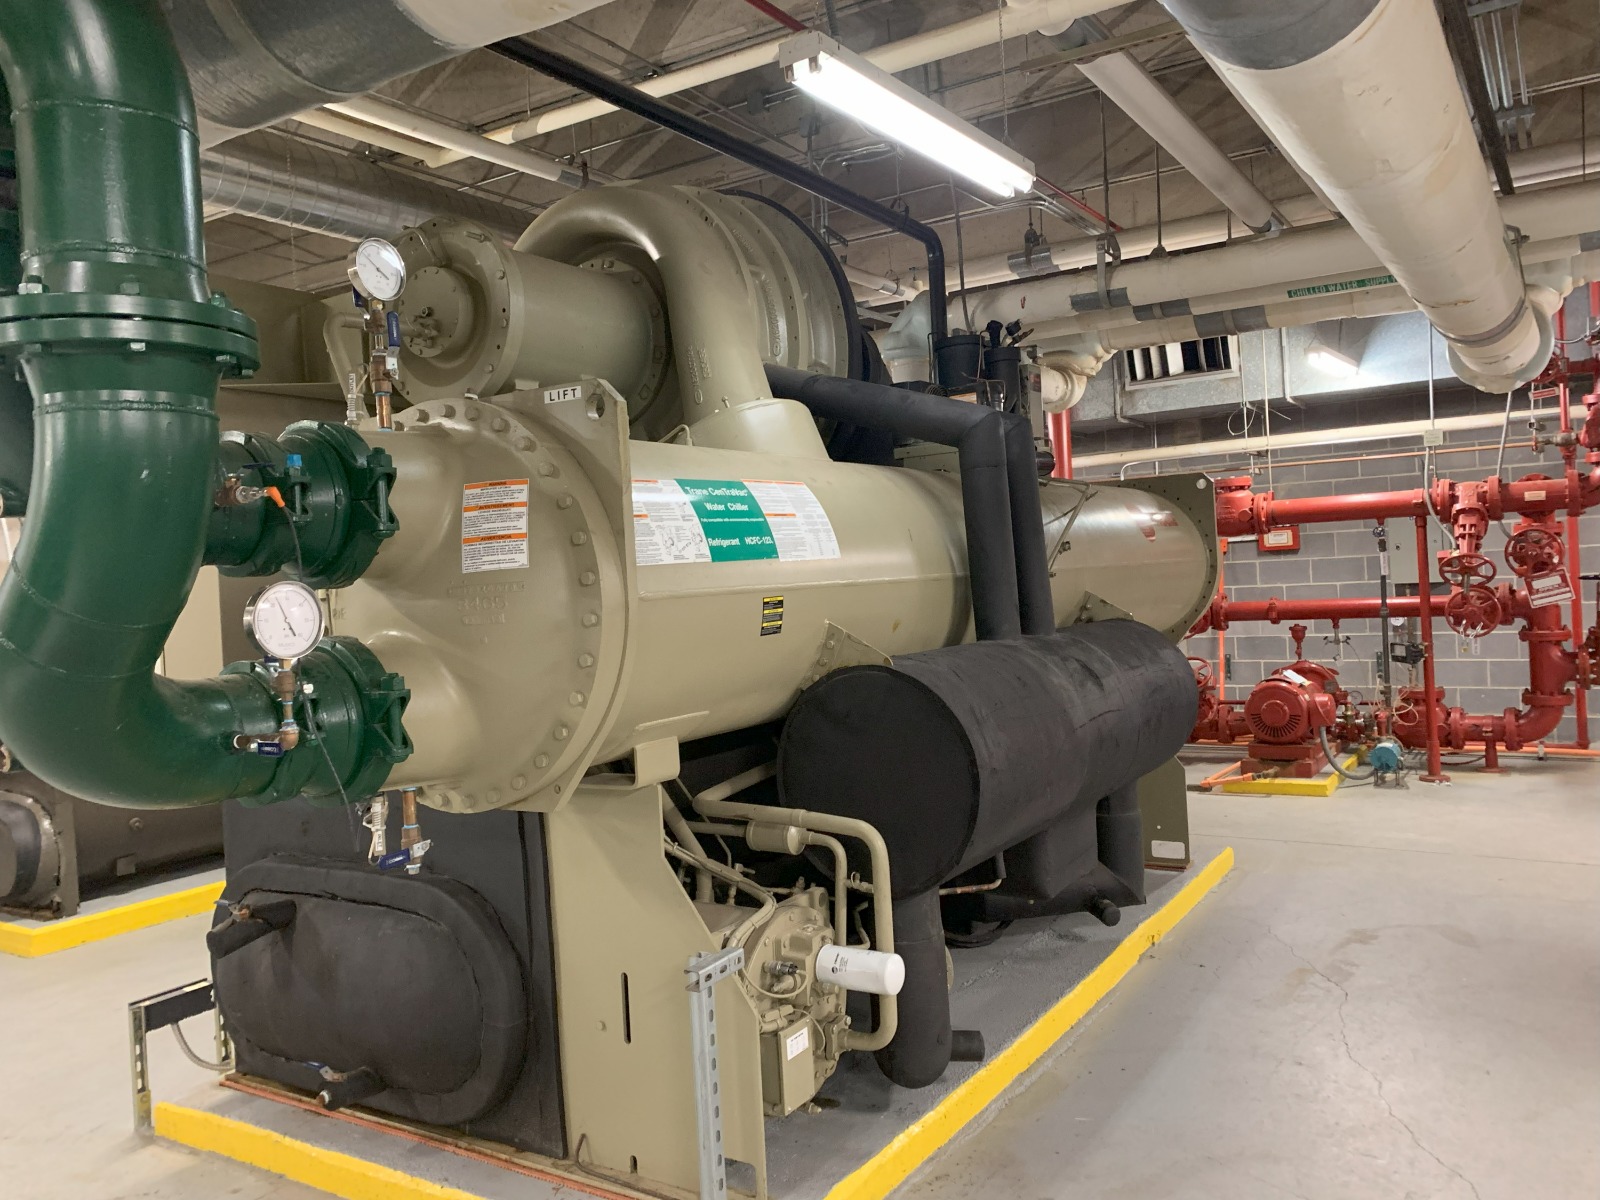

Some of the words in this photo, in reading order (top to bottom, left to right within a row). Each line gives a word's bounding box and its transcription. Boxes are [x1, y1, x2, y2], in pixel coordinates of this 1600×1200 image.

[1291, 285, 1326, 298] CHILLED
[1329, 281, 1357, 292] WATER
[549, 387, 577, 402] LIFT
[685, 486, 708, 496] Trane
[704, 502, 726, 511] Water
[727, 502, 749, 511] Chiller
[708, 538, 740, 548] Refrigerant
